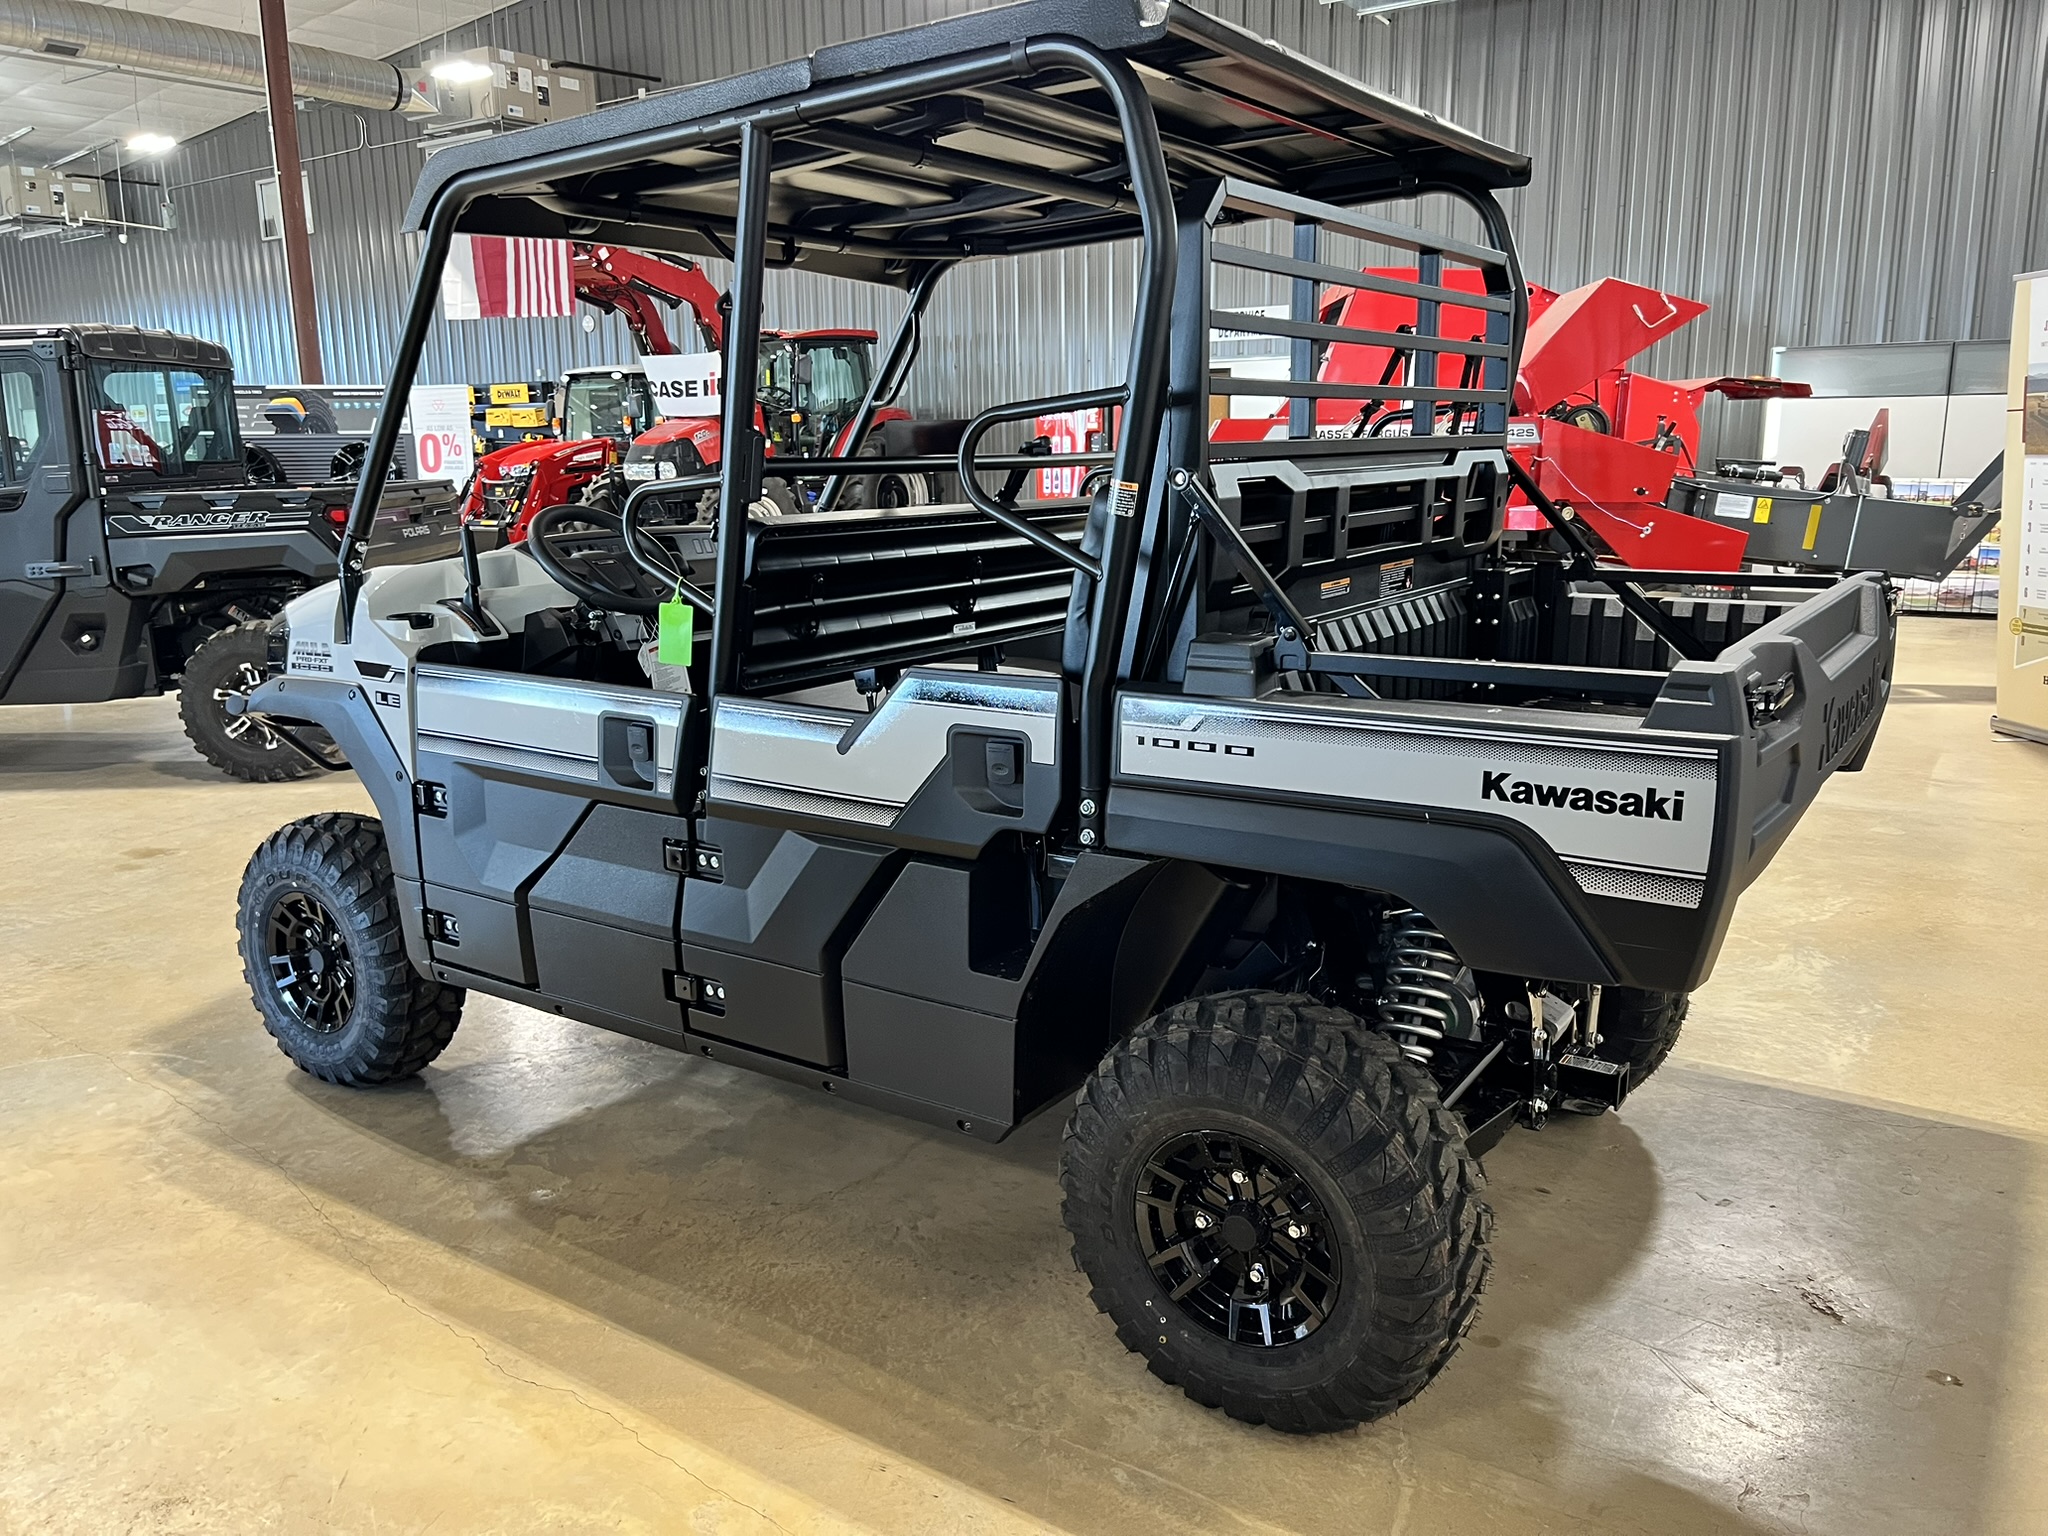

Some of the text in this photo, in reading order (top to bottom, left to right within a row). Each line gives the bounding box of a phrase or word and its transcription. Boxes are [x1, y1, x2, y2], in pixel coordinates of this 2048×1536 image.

[648, 380, 698, 398] CASE
[420, 433, 462, 473] 0%
[151, 511, 270, 527] RANGER
[292, 641, 332, 657] MULE
[376, 691, 400, 708] LE
[1136, 735, 1254, 757] 1000
[1481, 770, 1685, 821] Kawasaki
